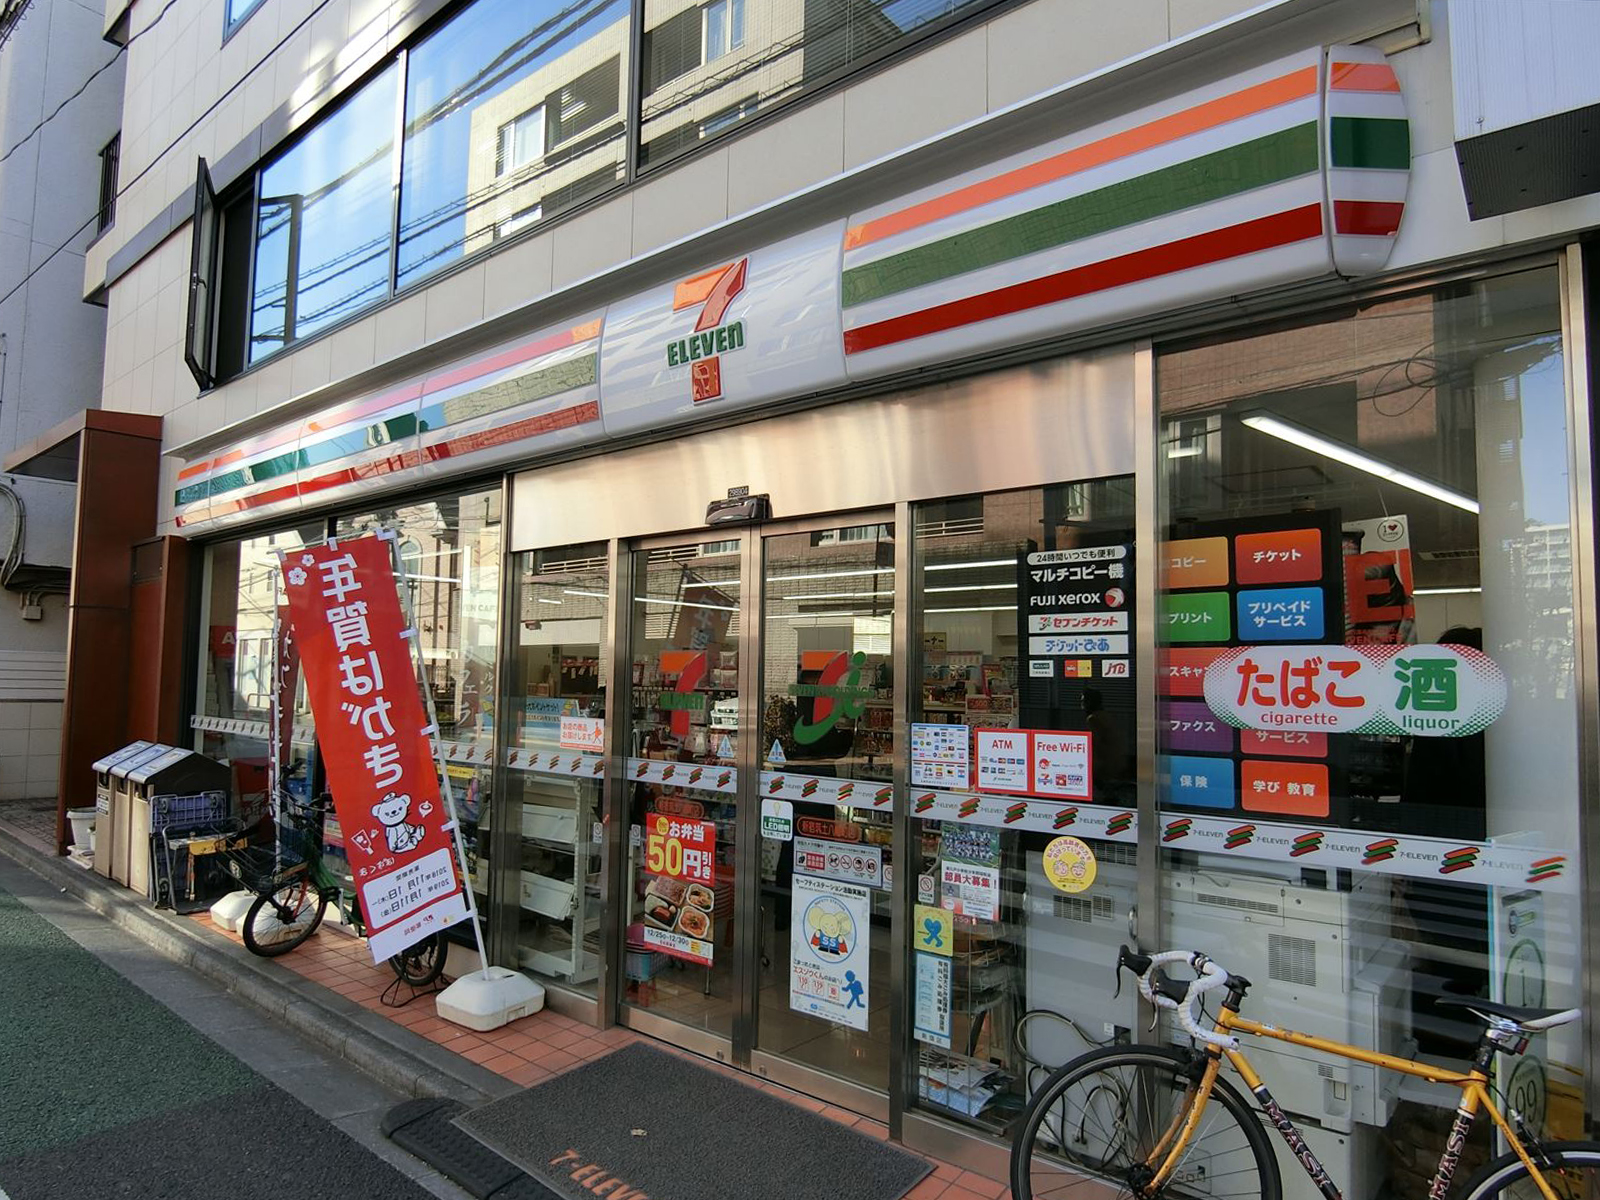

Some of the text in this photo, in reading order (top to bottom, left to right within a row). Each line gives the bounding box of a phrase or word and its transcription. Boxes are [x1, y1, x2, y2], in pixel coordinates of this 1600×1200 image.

[673, 258, 748, 403] 7
[1036, 548, 1116, 563] 24時間いつでも便利
[1253, 549, 1302, 563] チケット
[1030, 563, 1124, 583] マルチコピー機
[1030, 595, 1055, 606] FUJI
[1248, 601, 1311, 615] プリペイド
[1053, 616, 1118, 628] セブンチケット
[1169, 612, 1213, 625] プリント
[1253, 614, 1307, 628] サービス
[1045, 638, 1110, 652] チケットぴあ
[1169, 666, 1210, 678] スキャ
[1237, 656, 1365, 709] たばこ
[1394, 657, 1458, 711] 酒
[1260, 711, 1338, 726] cigarette
[1402, 715, 1460, 731] liquor
[1170, 720, 1216, 733] ファクス
[562, 731, 592, 741] お届けします
[1256, 730, 1310, 744] サービス
[992, 739, 1013, 750] ATM
[1037, 742, 1086, 754] Free Wi-Fi
[1179, 774, 1208, 789] 保険
[1253, 779, 1317, 797] 学び 教育
[669, 821, 704, 842] お弁当
[764, 822, 790, 833] LED照明
[1263, 1099, 1330, 1188] MASI
[1429, 1120, 1470, 1200] MASI
